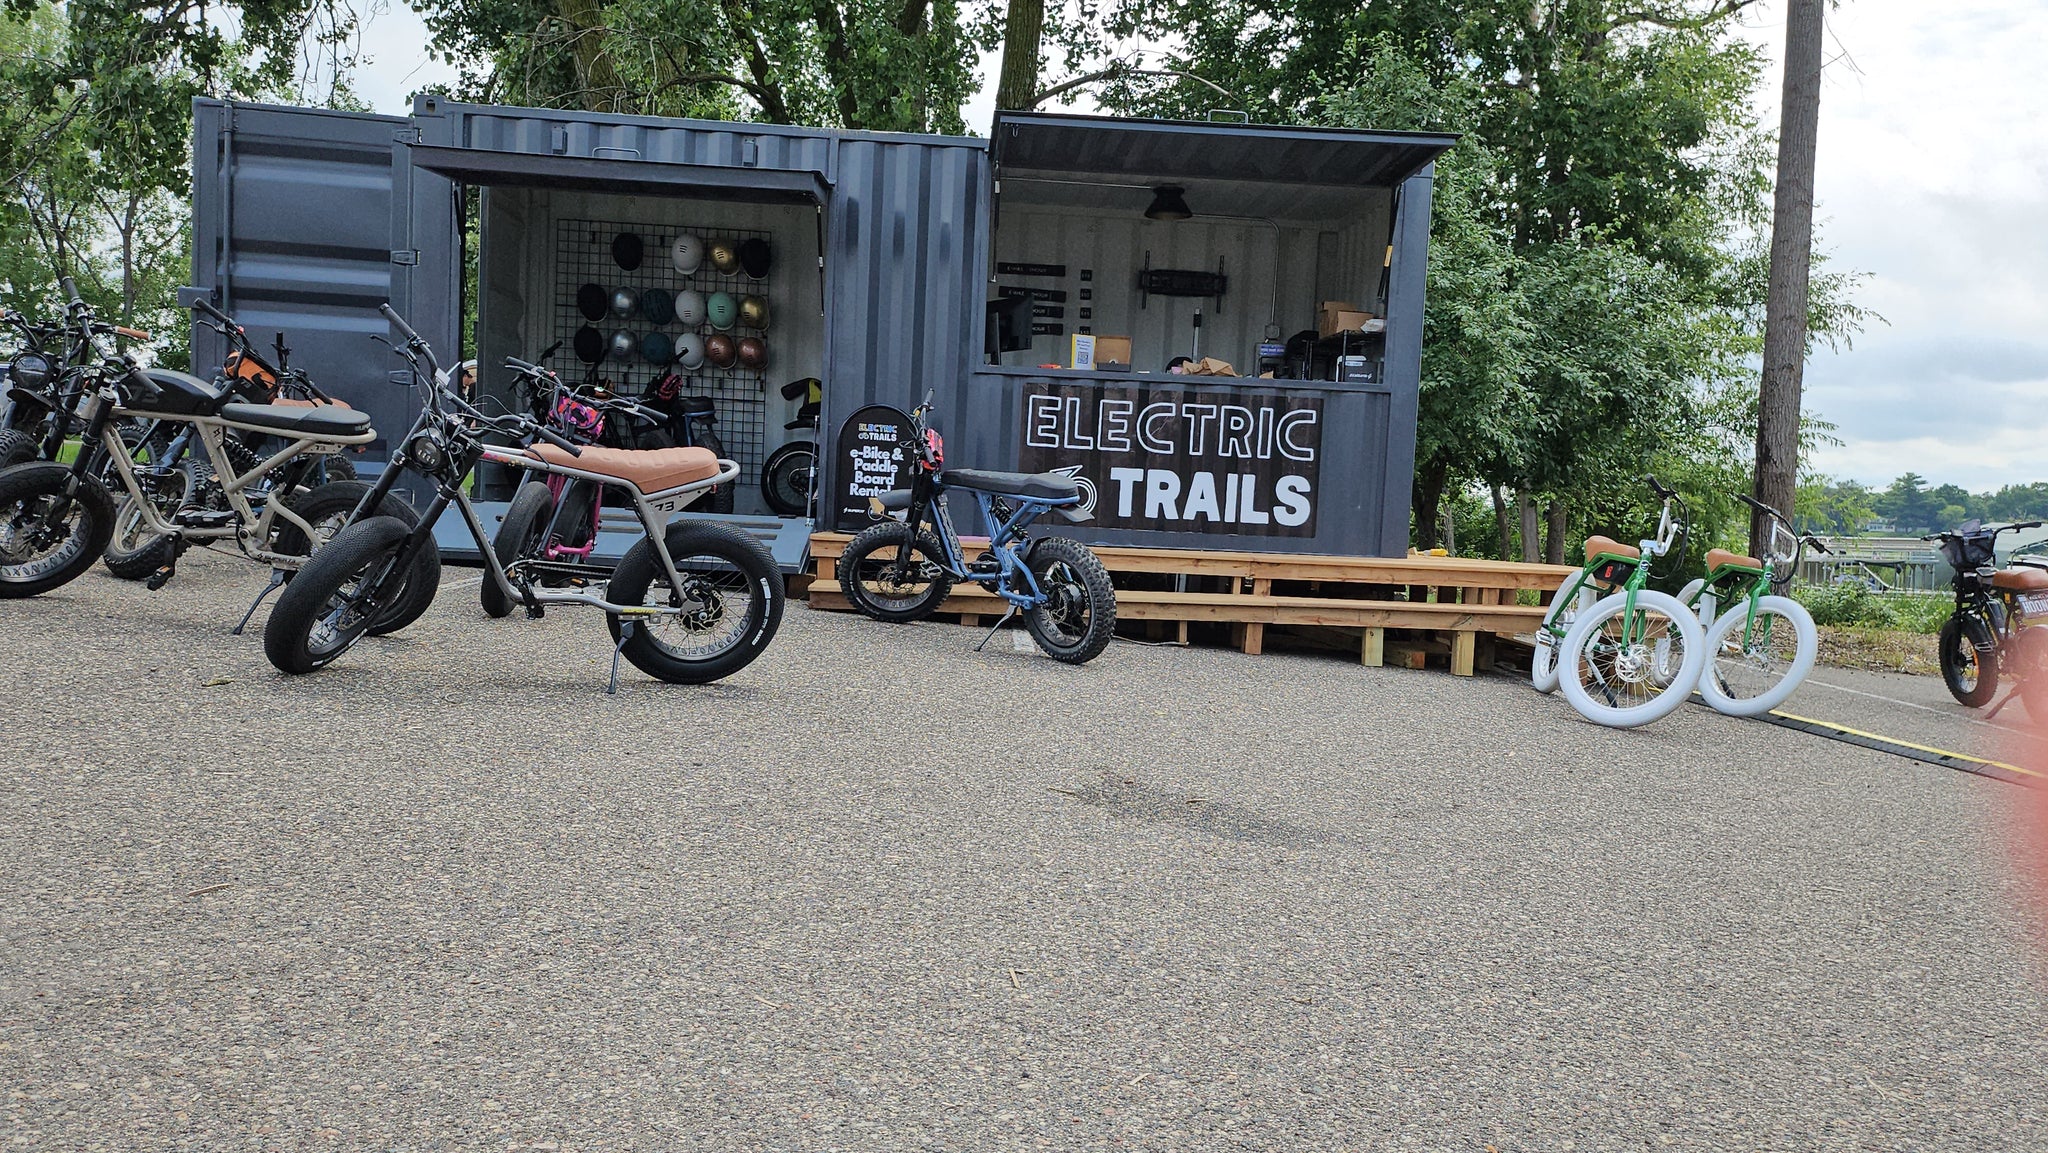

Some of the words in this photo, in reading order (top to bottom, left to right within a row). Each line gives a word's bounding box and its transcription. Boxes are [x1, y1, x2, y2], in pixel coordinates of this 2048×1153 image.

[859, 423, 897, 433] ELECTRIC
[1026, 394, 1317, 461] ELECTRIC
[869, 432, 897, 442] TRAILS
[850, 446, 890, 459] e-Bike
[892, 447, 904, 461] &
[854, 458, 899, 473] Paddle
[855, 471, 895, 485] Board
[1110, 467, 1311, 527] TRAILS
[654, 501, 675, 512] 73
